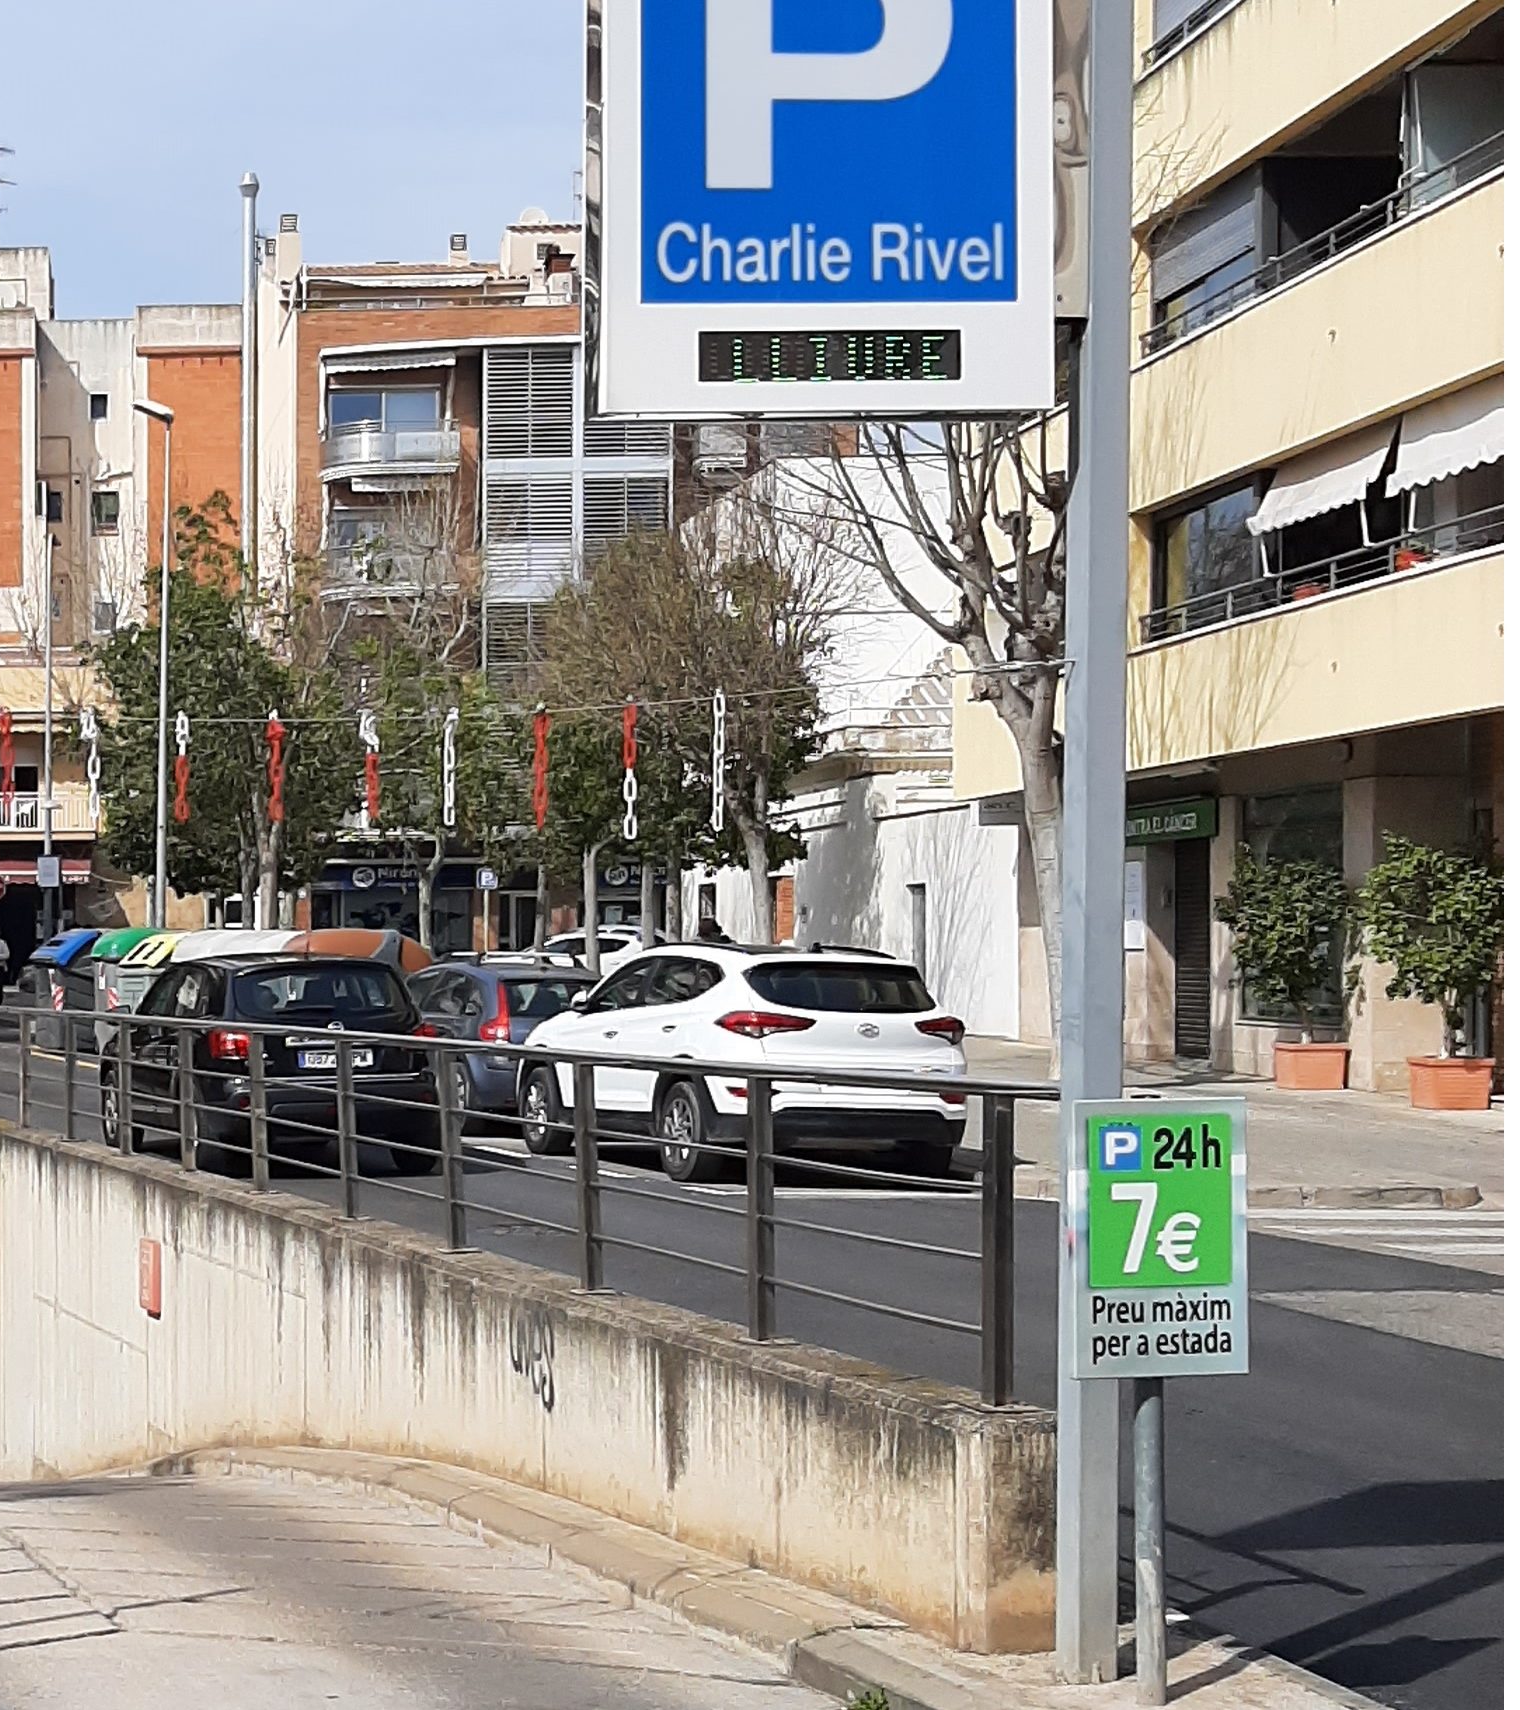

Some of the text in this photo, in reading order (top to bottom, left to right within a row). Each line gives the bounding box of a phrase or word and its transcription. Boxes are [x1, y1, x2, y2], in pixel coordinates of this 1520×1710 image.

[705, 0, 954, 189] P
[657, 222, 1004, 284] Charlie Rivel
[732, 336, 948, 384] LLIURE
[1105, 1131, 1138, 1166] P
[1110, 1182, 1202, 1275] 7€
[1092, 1292, 1232, 1324] Preu màxim
[1092, 1324, 1233, 1365] per a estada
